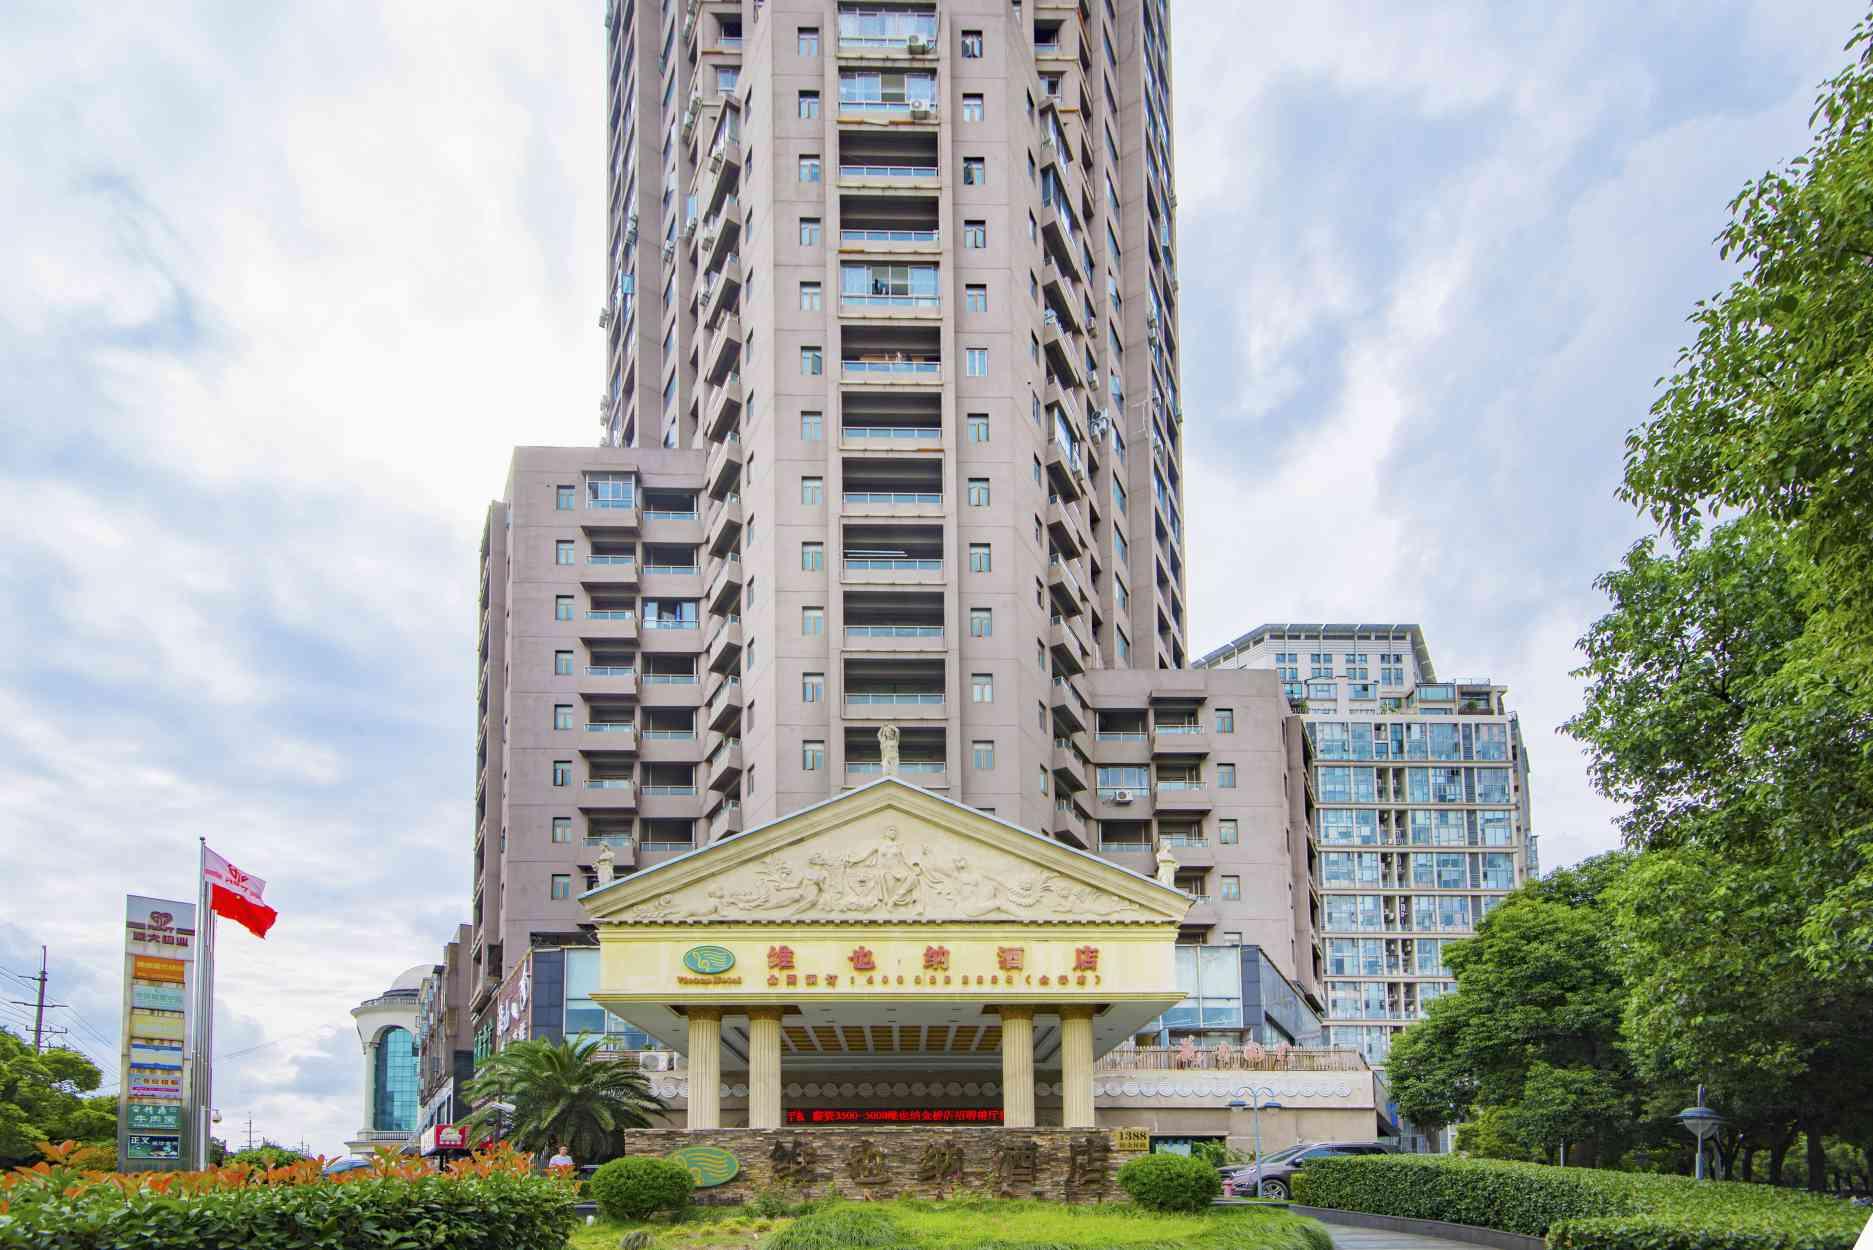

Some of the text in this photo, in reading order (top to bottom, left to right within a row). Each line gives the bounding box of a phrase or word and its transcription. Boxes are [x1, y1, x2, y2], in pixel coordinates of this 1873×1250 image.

[767, 945, 1100, 971] 维也纳酒店
[1120, 1130, 1146, 1140] 1388
